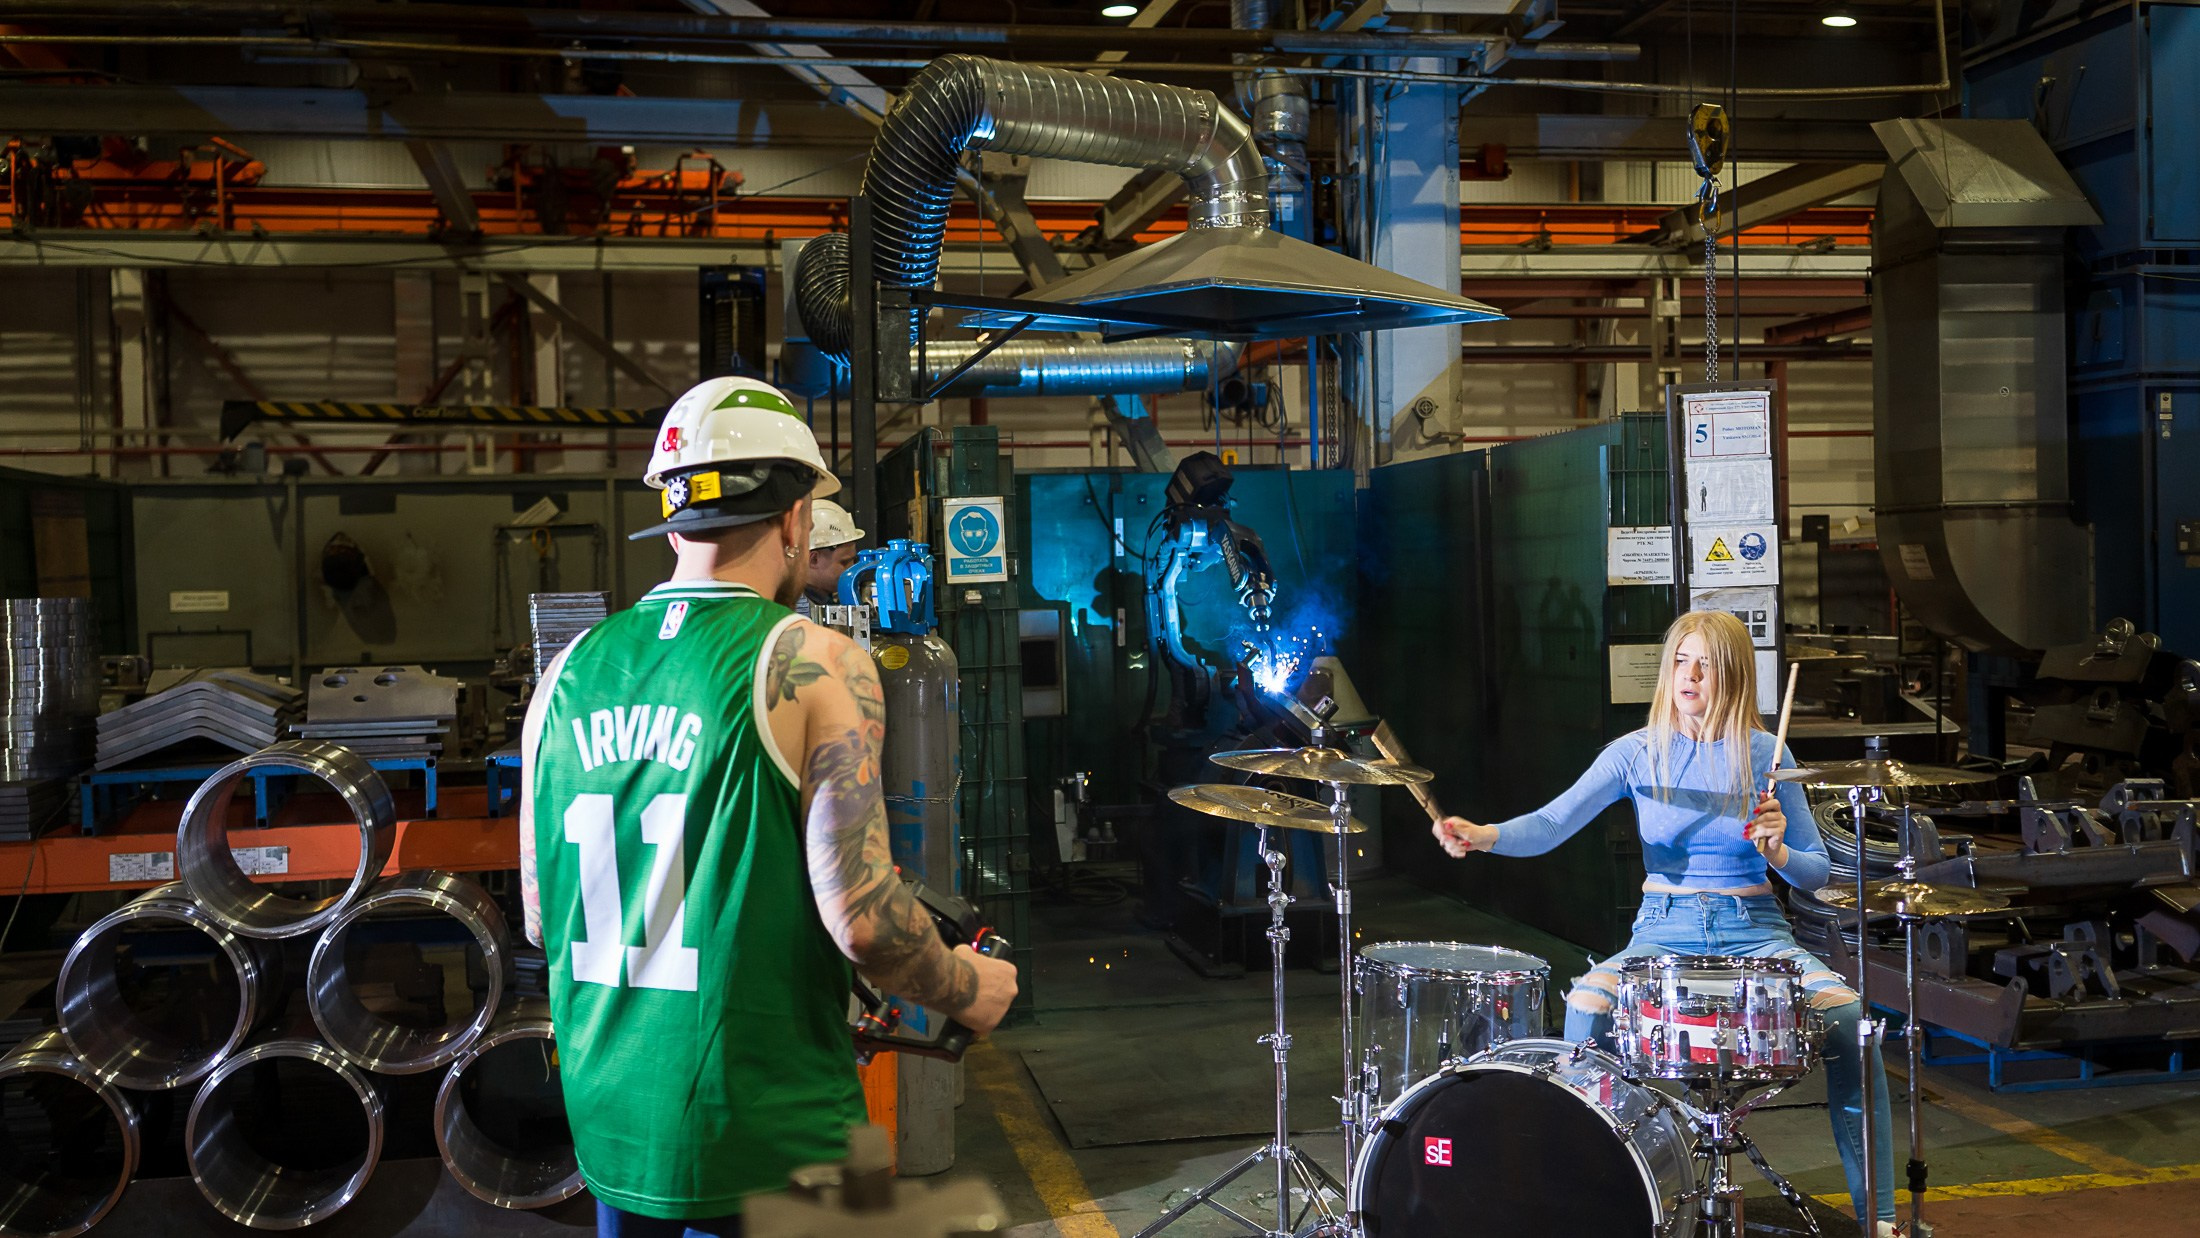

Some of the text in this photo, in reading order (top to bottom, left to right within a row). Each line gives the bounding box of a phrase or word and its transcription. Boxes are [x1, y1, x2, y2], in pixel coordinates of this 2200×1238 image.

[1695, 423, 1708, 443] 5
[1221, 533, 1241, 583] YASKAWA
[571, 703, 702, 772] IRVING
[563, 793, 698, 991] 11
